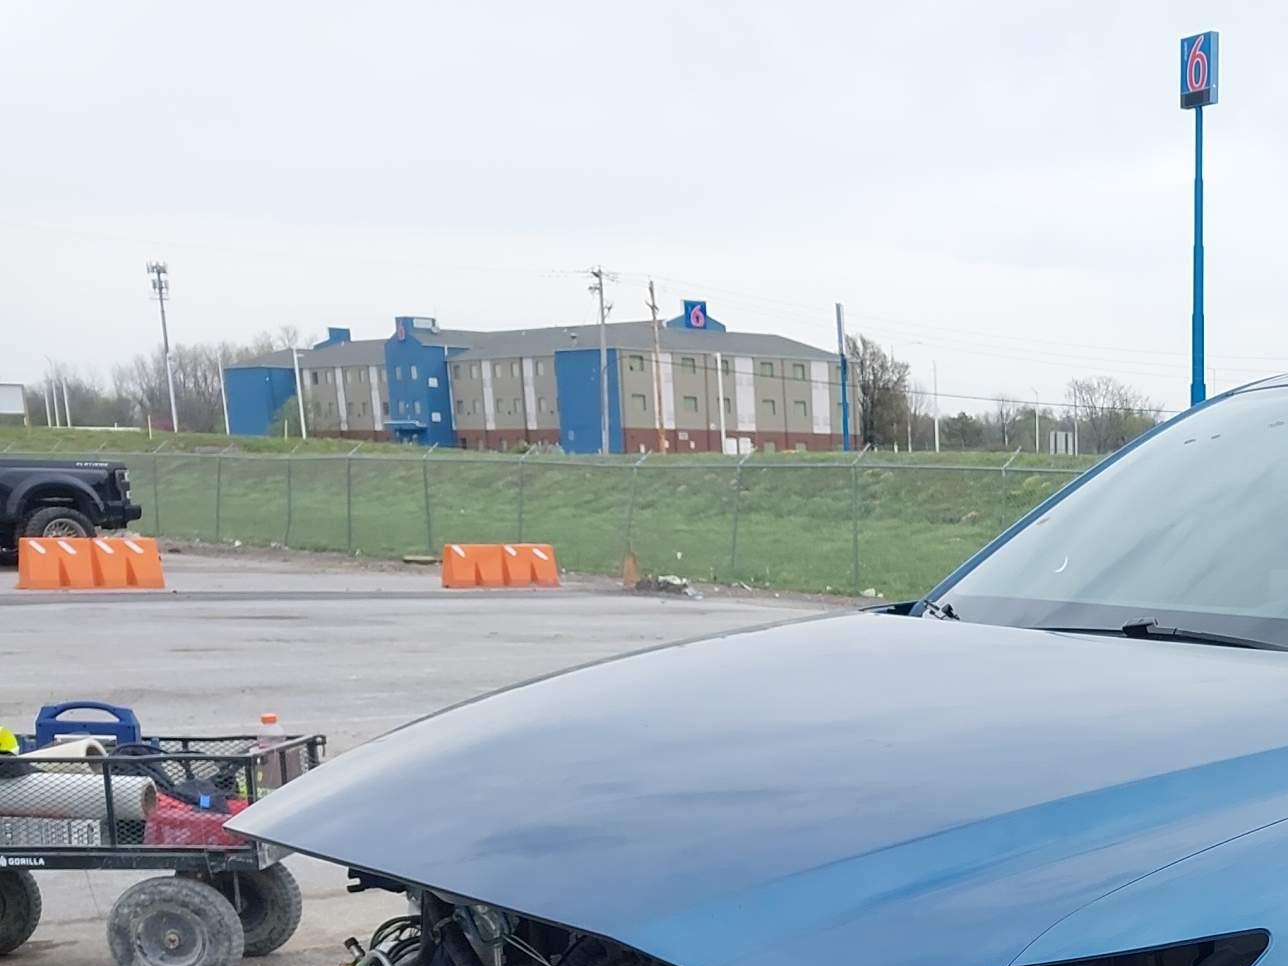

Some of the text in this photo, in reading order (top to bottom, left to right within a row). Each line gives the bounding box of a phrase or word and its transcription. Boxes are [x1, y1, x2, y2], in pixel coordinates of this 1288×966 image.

[1186, 35, 1208, 92] 6
[690, 304, 705, 328] 6
[8, 857, 45, 866] GORILLA
